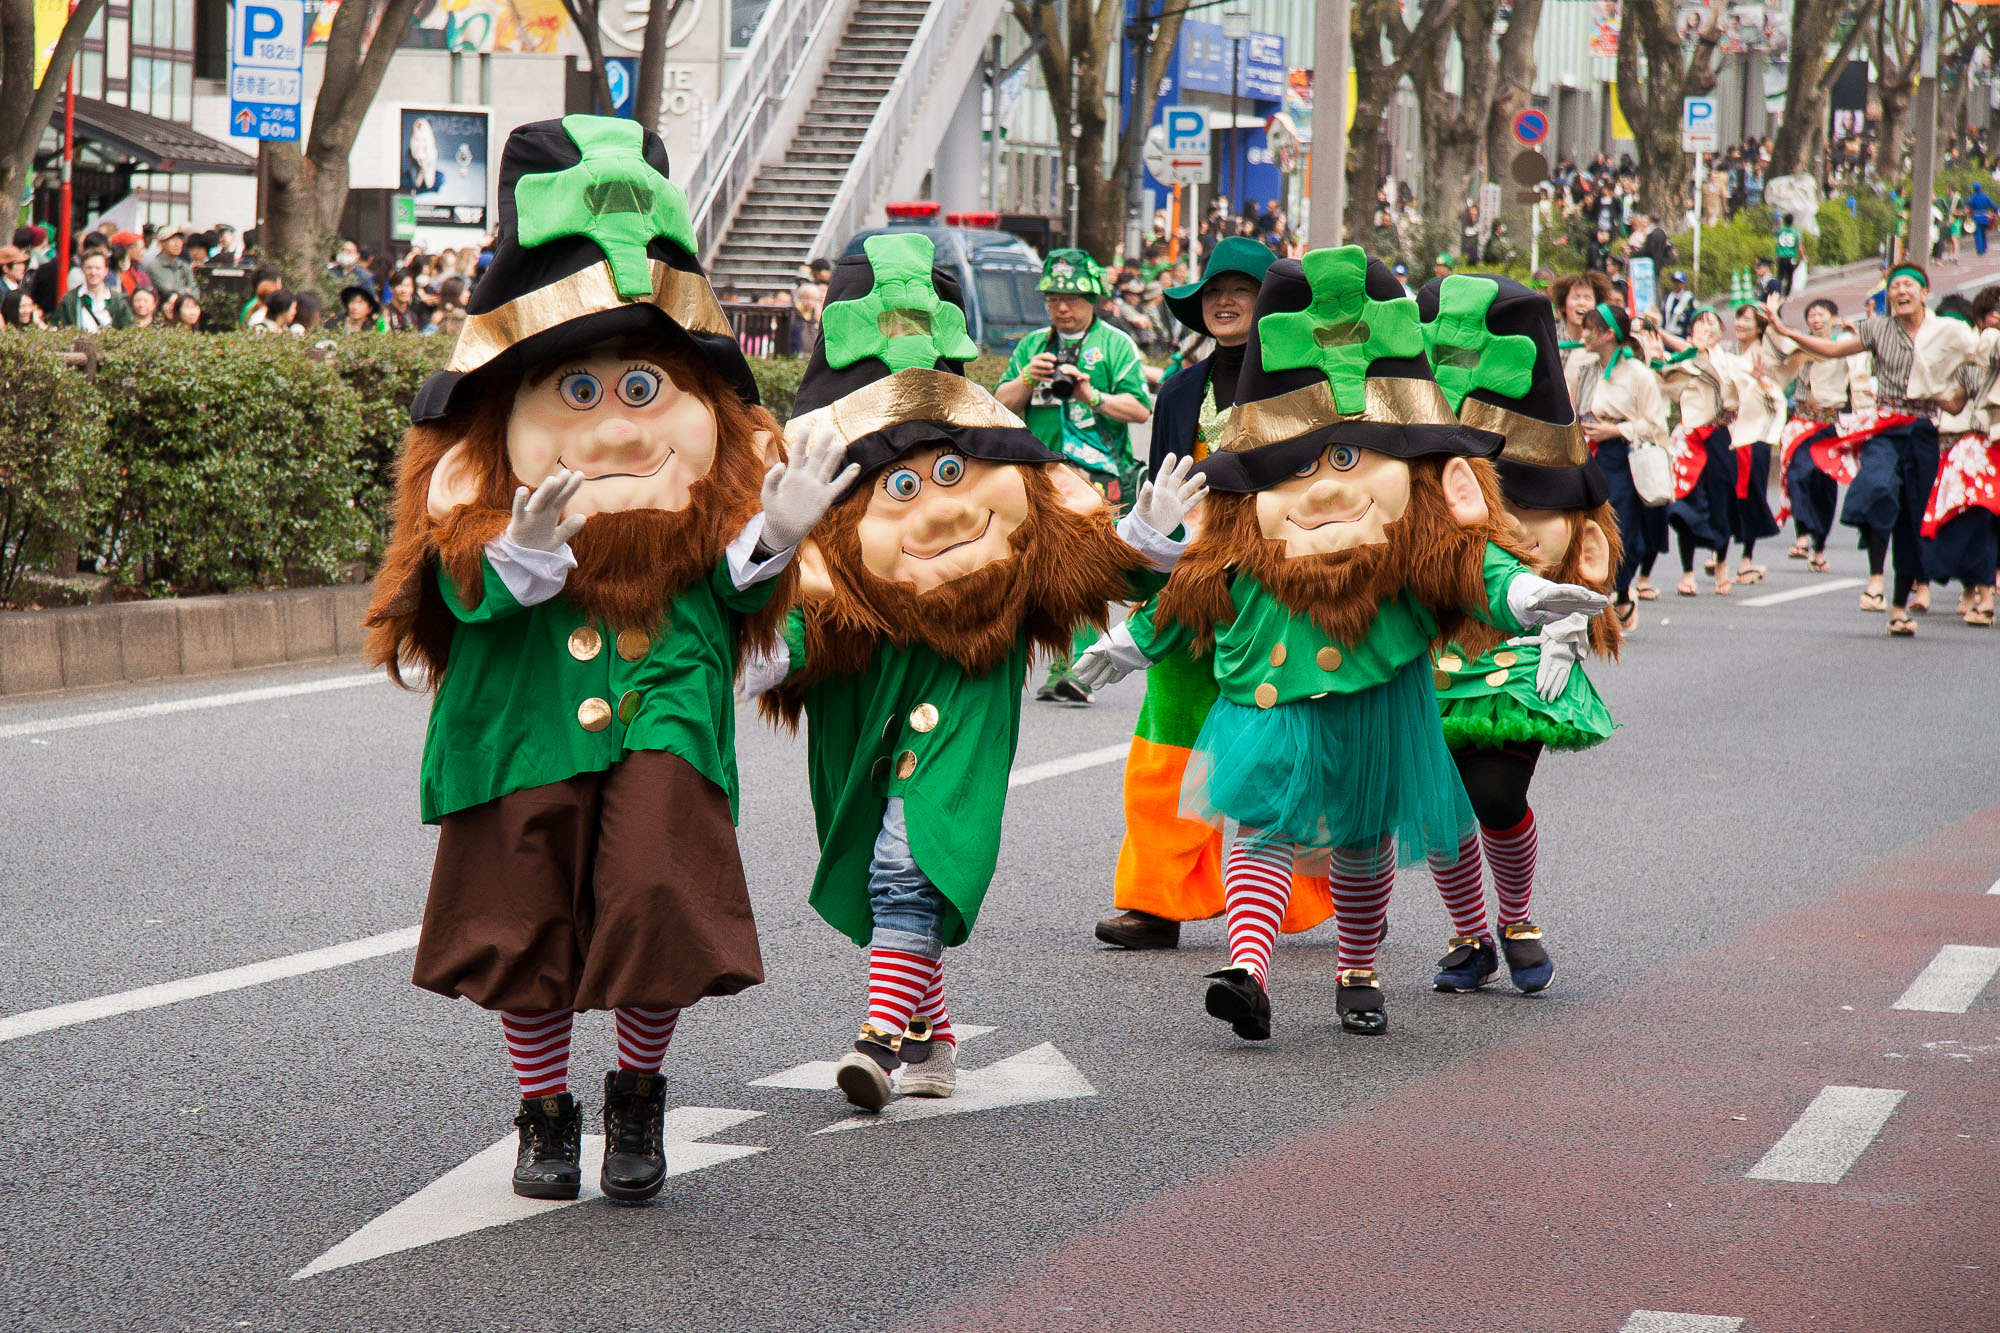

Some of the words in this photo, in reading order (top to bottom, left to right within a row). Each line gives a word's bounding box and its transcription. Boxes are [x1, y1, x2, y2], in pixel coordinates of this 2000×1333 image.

[244, 5, 283, 57] P
[261, 107, 296, 121] この先
[1689, 102, 1712, 127] P
[260, 121, 296, 138] 80m
[425, 116, 486, 136] MEGA
[1169, 111, 1204, 149] P
